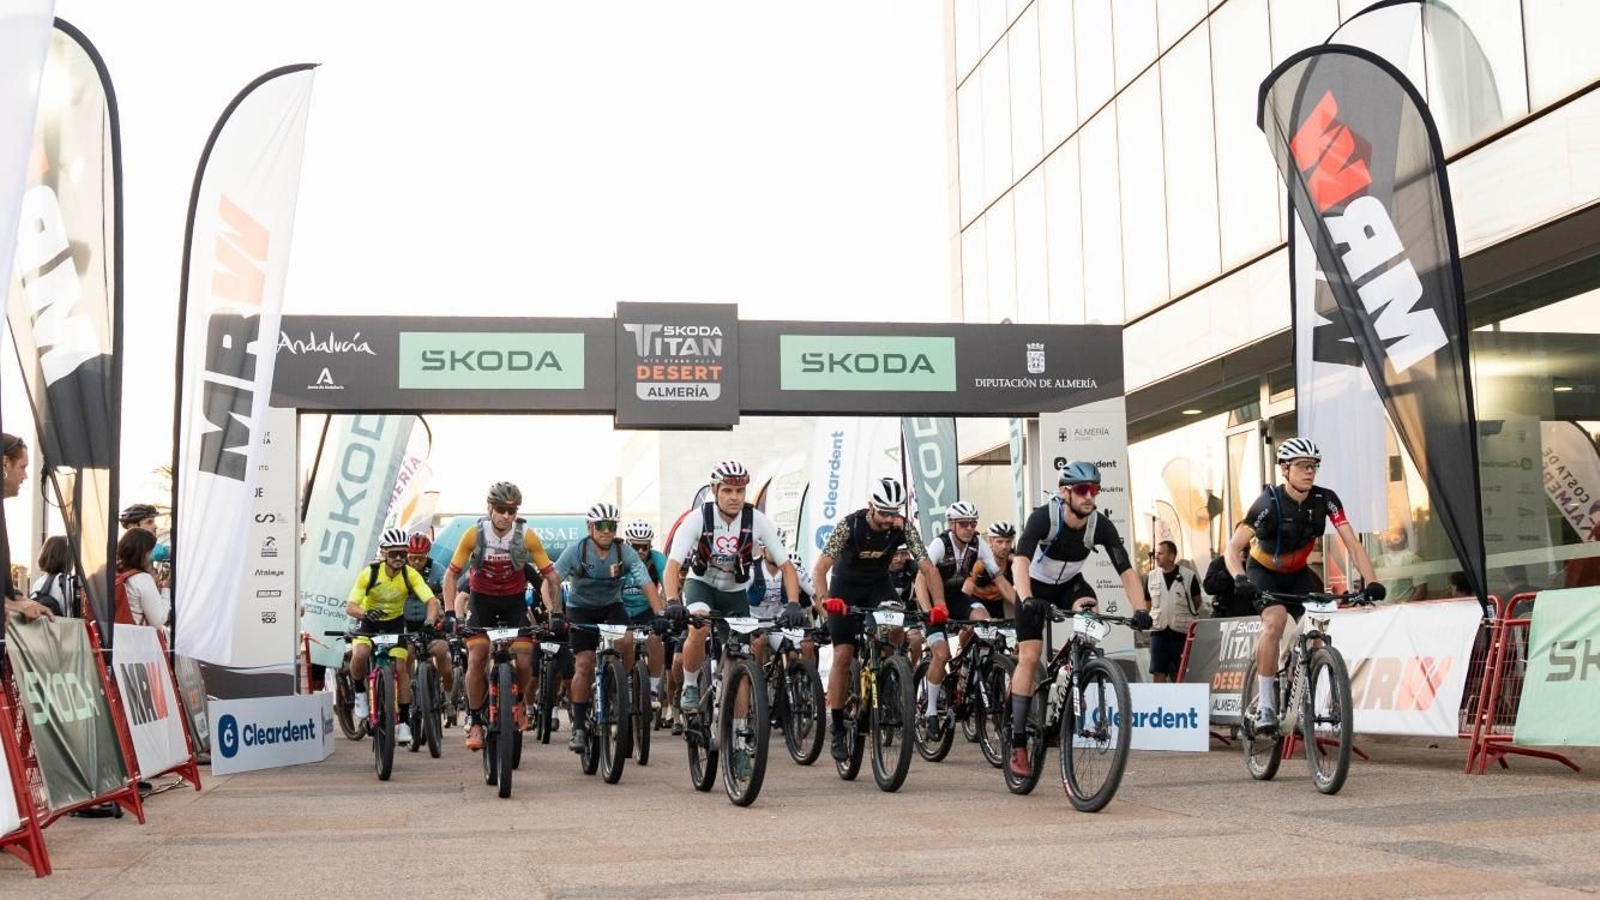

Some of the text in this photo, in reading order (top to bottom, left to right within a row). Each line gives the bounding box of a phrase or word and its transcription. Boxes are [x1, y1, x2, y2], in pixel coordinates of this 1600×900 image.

[200, 192, 271, 483] MRW
[623, 323, 722, 357] TITAN
[663, 326, 723, 336] SKODA
[277, 331, 377, 355] Andalucía
[421, 350, 563, 372] SKODA
[801, 353, 935, 374] SKODA
[636, 365, 723, 380] DESERT
[975, 377, 1098, 389] DIPUTACIÓN DE ALMERÍA
[647, 385, 709, 397] ALMERÍA
[824, 431, 844, 520] Cleardent
[243, 718, 315, 746] Cleardent
